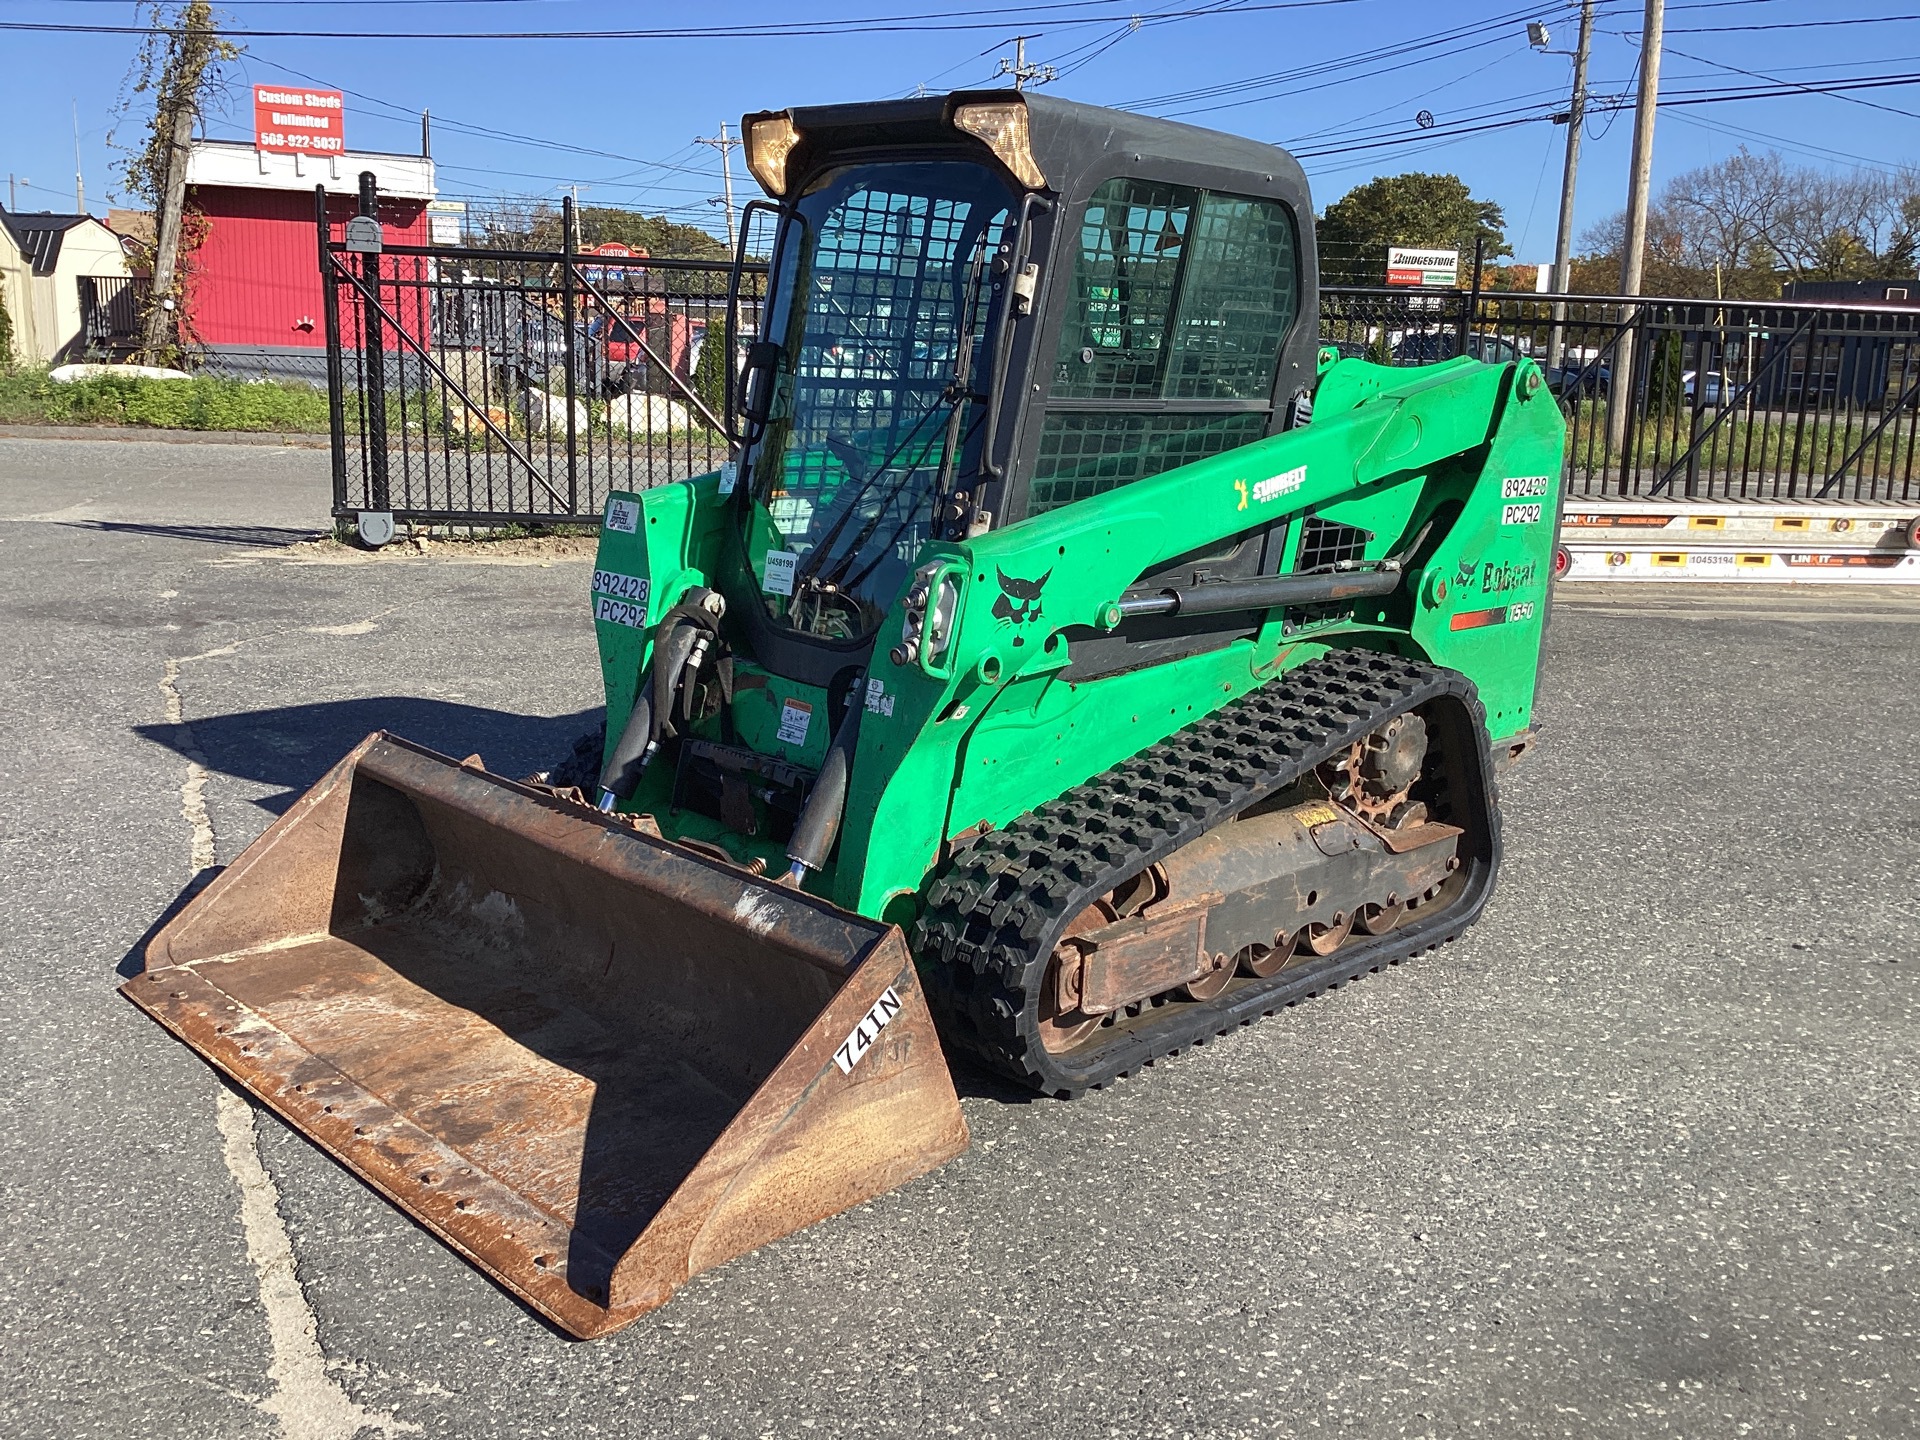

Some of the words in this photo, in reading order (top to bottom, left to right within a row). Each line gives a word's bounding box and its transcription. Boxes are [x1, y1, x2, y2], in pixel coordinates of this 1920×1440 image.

[258, 90, 303, 105] Custom
[305, 94, 341, 108] Sheds
[272, 112, 329, 128] Unlimited
[260, 132, 342, 150] 508-922-5037
[599, 248, 629, 257] CUSTOM
[1393, 253, 1455, 266] BRIDGESTONE
[1252, 465, 1308, 500] SUNBELT
[1260, 483, 1301, 504] RENTALS
[1505, 504, 1541, 524] PC292
[767, 556, 794, 569] U458199
[1691, 554, 1734, 565] 10453194
[1790, 553, 1832, 565] LINKIT
[592, 571, 649, 601] 892428
[600, 599, 646, 629] PC292
[836, 989, 901, 1069] 74IN
